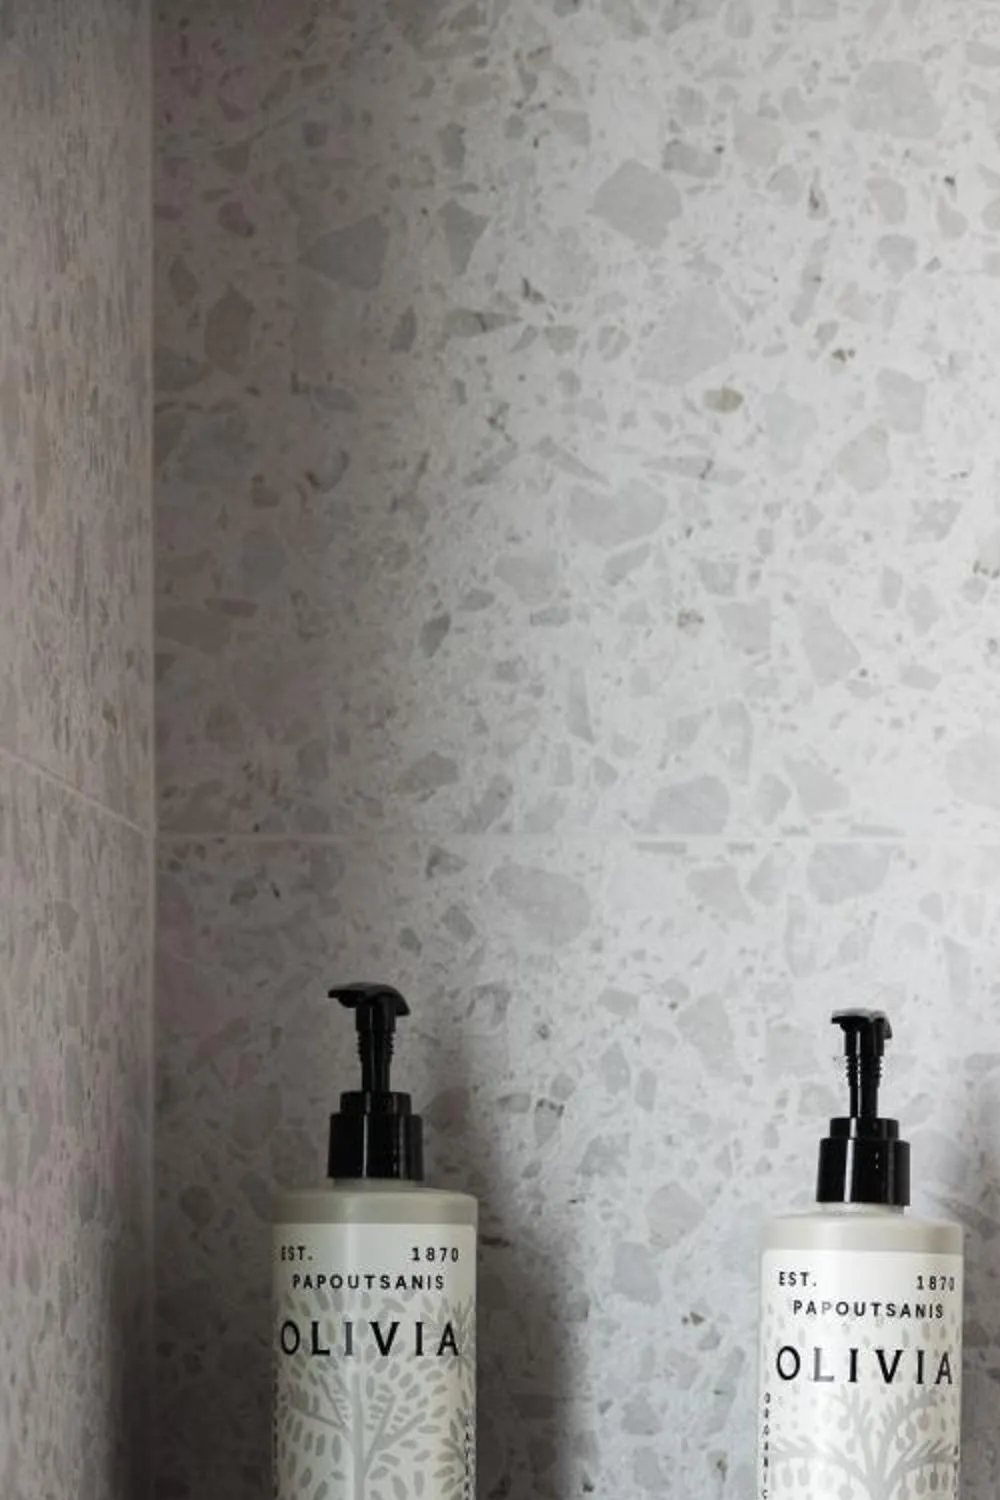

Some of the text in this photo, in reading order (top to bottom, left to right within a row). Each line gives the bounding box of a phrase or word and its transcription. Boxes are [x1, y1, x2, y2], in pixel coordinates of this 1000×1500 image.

[281, 1246, 460, 1262] EST. 1870
[292, 1274, 445, 1290] PAPOUTSANIS
[778, 1271, 956, 1291] EST. 1870
[793, 1300, 944, 1319] PAPOUTSANIS
[280, 1320, 460, 1357] OLIVIA
[776, 1345, 953, 1385] OLIVIA
